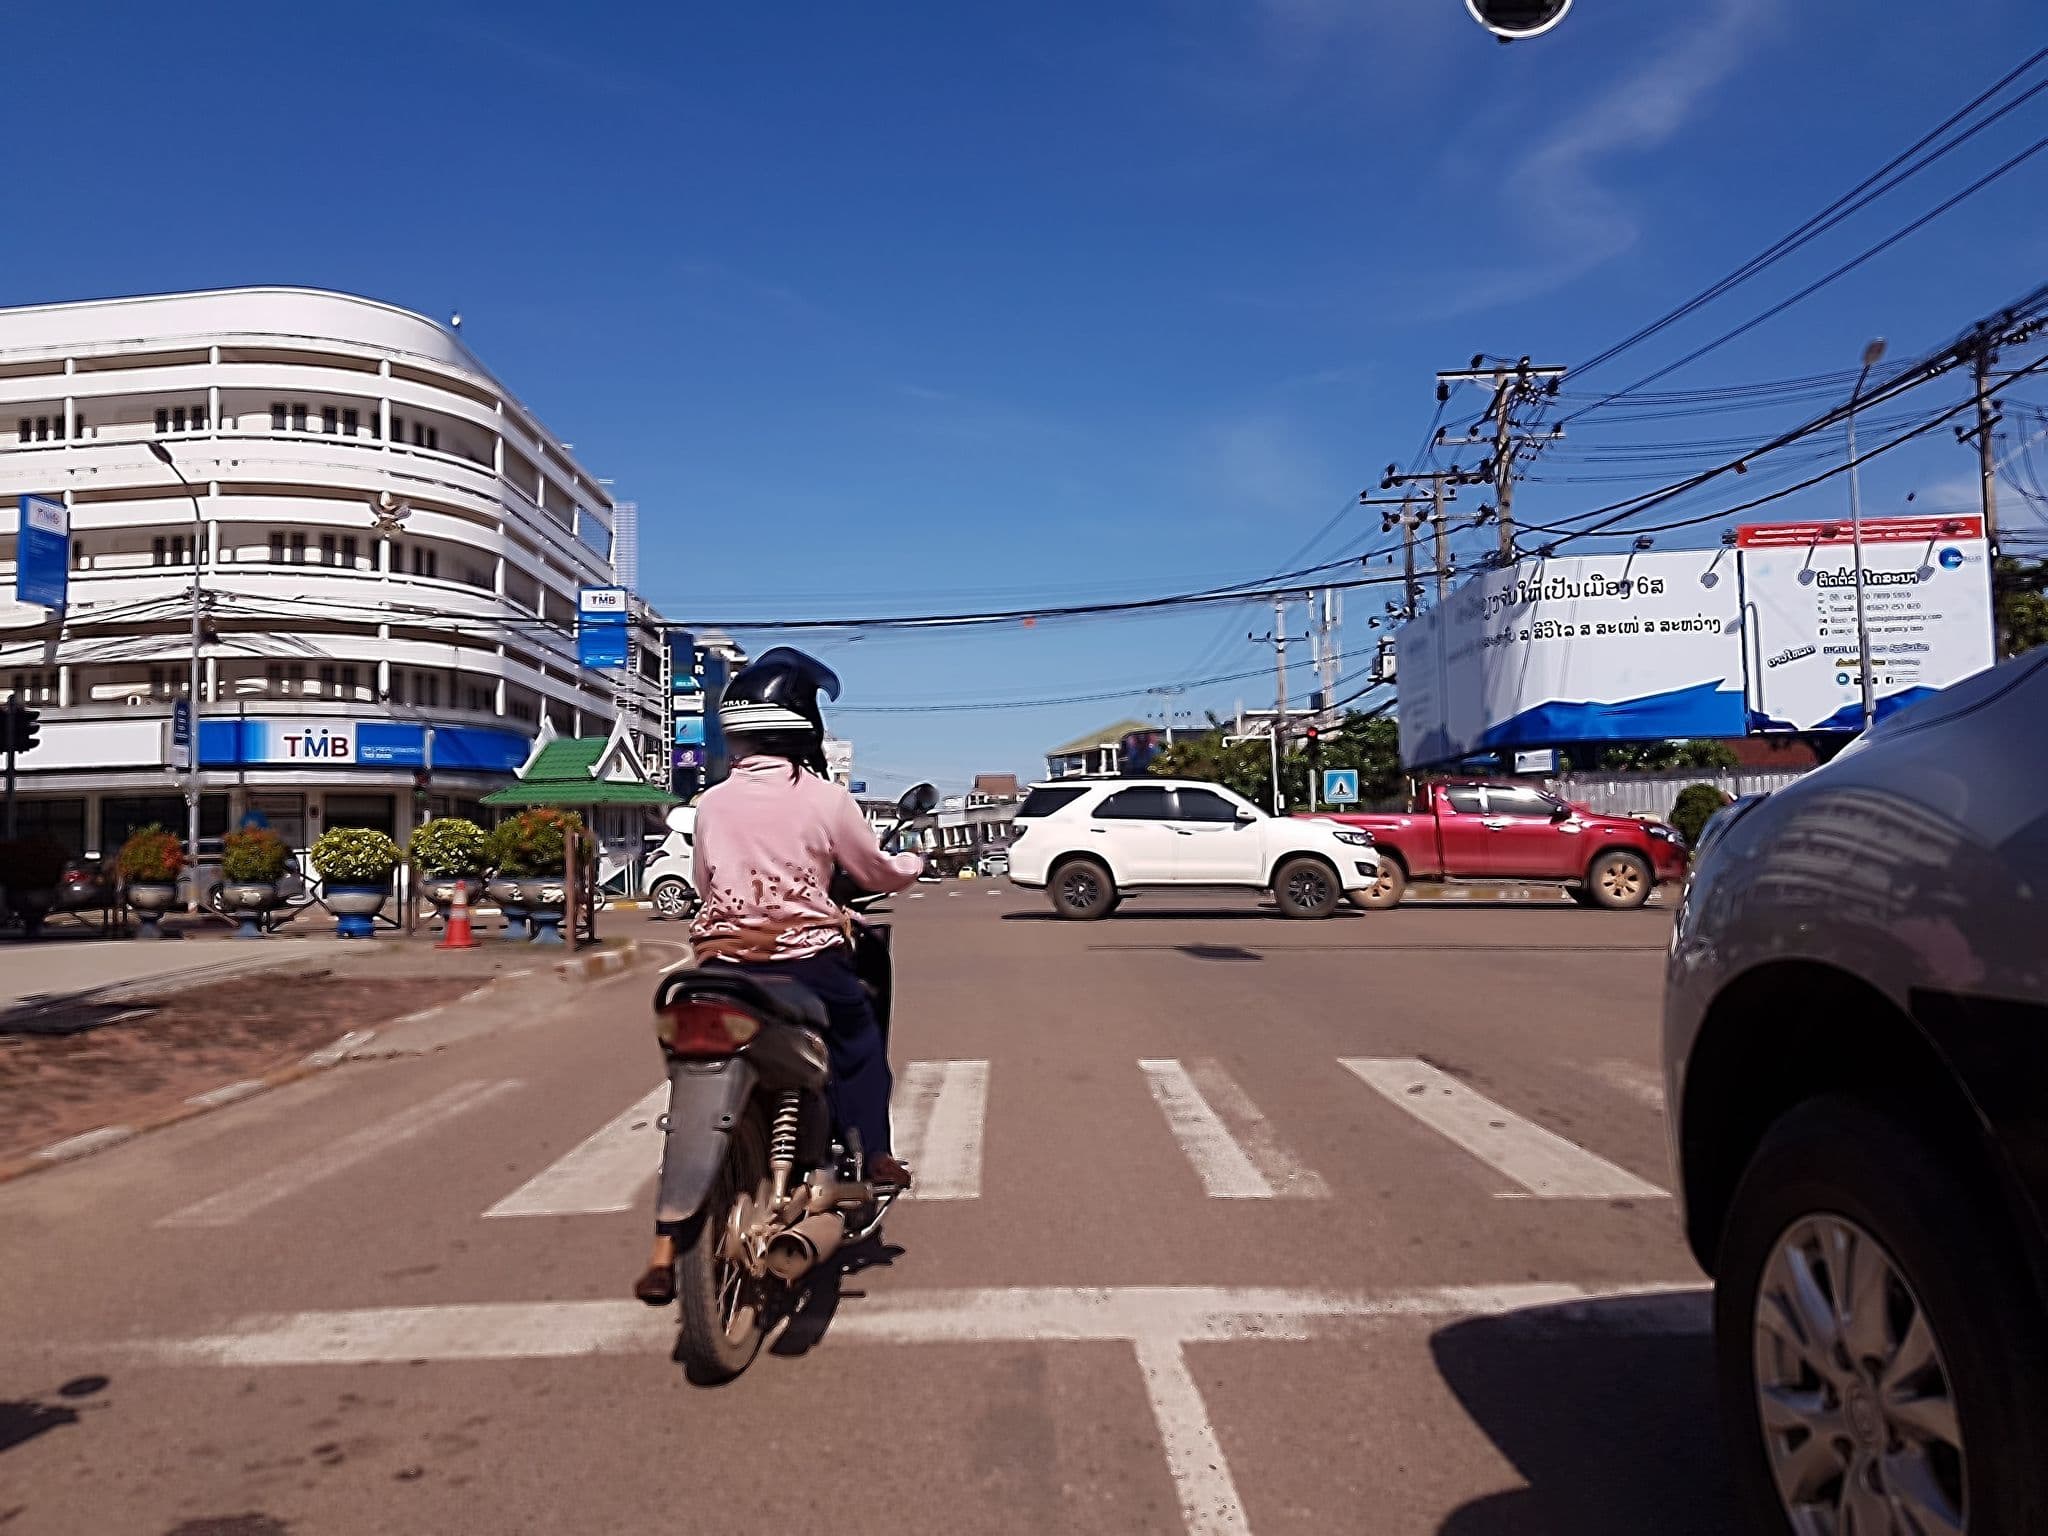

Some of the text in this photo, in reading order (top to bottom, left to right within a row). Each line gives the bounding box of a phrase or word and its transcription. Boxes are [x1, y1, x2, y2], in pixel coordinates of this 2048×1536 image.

[591, 593, 617, 605] TMB
[1580, 624, 1591, 636] ສ
[1644, 621, 1655, 633] ສ
[284, 729, 349, 757] TMB
